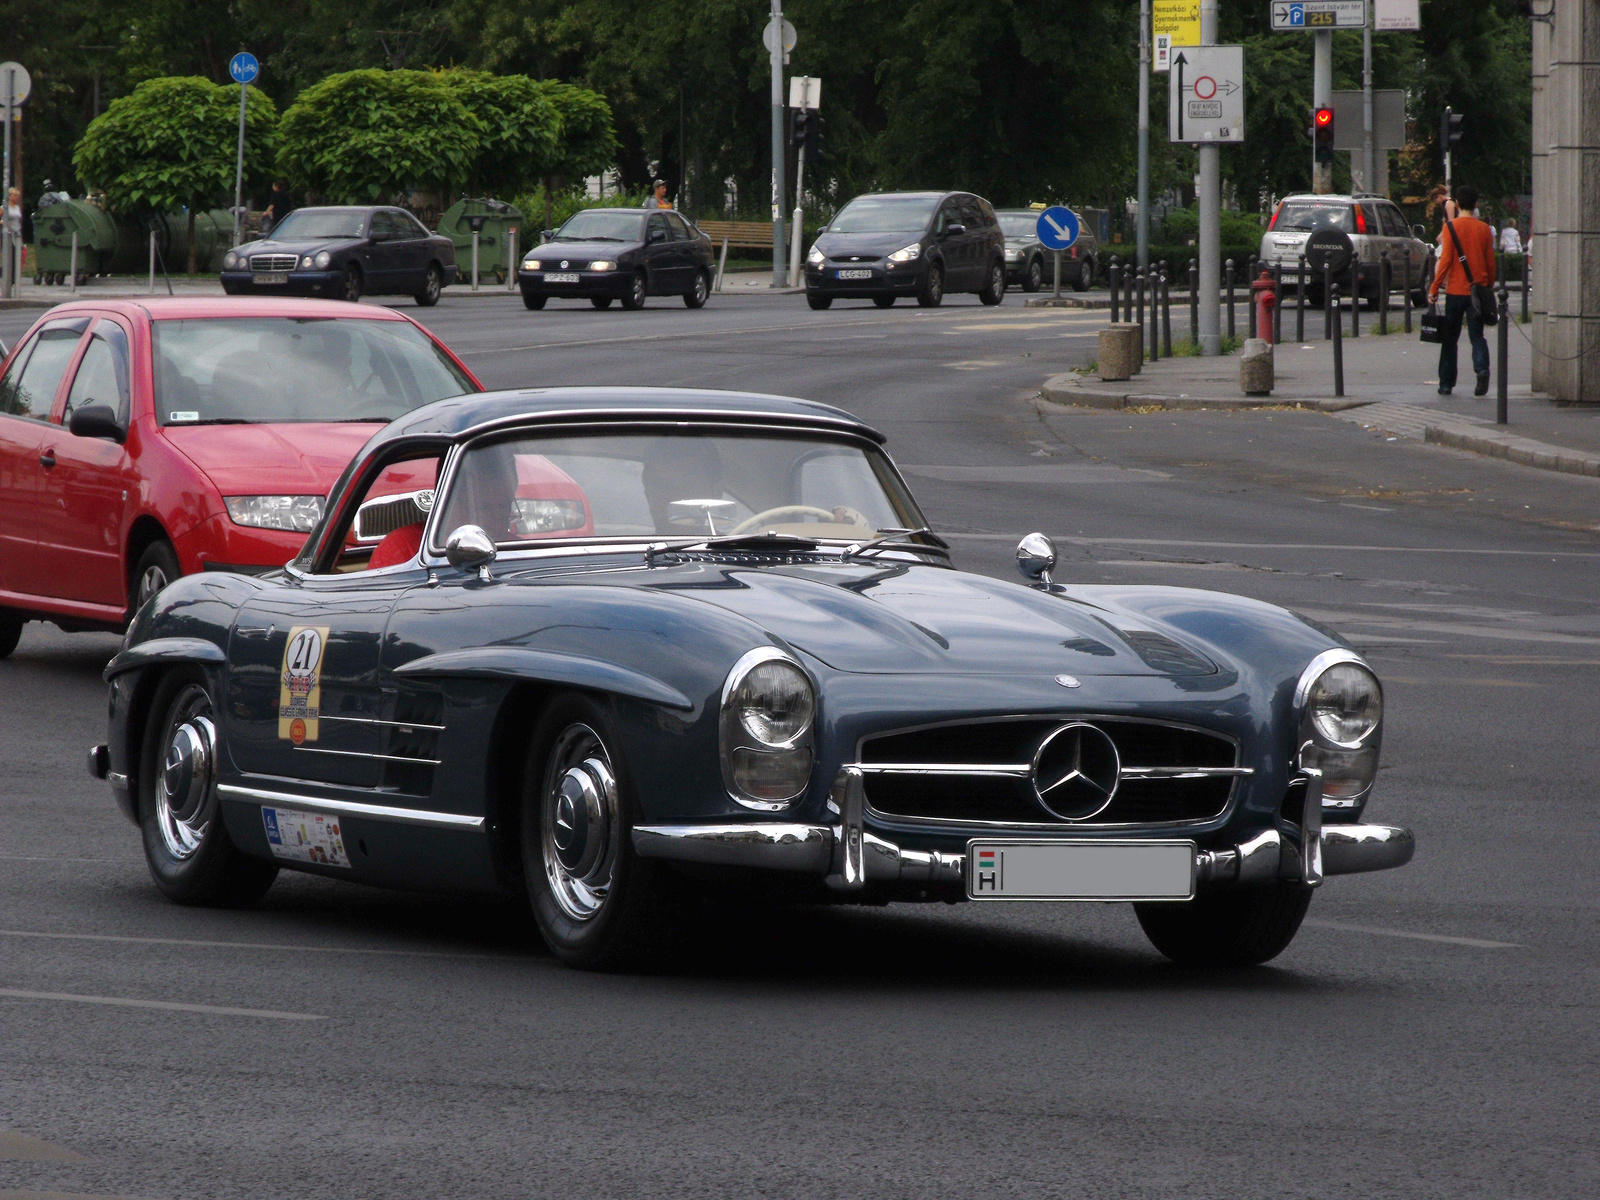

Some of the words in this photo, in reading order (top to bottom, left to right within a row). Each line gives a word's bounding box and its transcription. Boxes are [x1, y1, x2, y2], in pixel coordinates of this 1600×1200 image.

[1311, 12, 1333, 25] 215
[291, 633, 316, 670] 21
[979, 871, 996, 890] H
